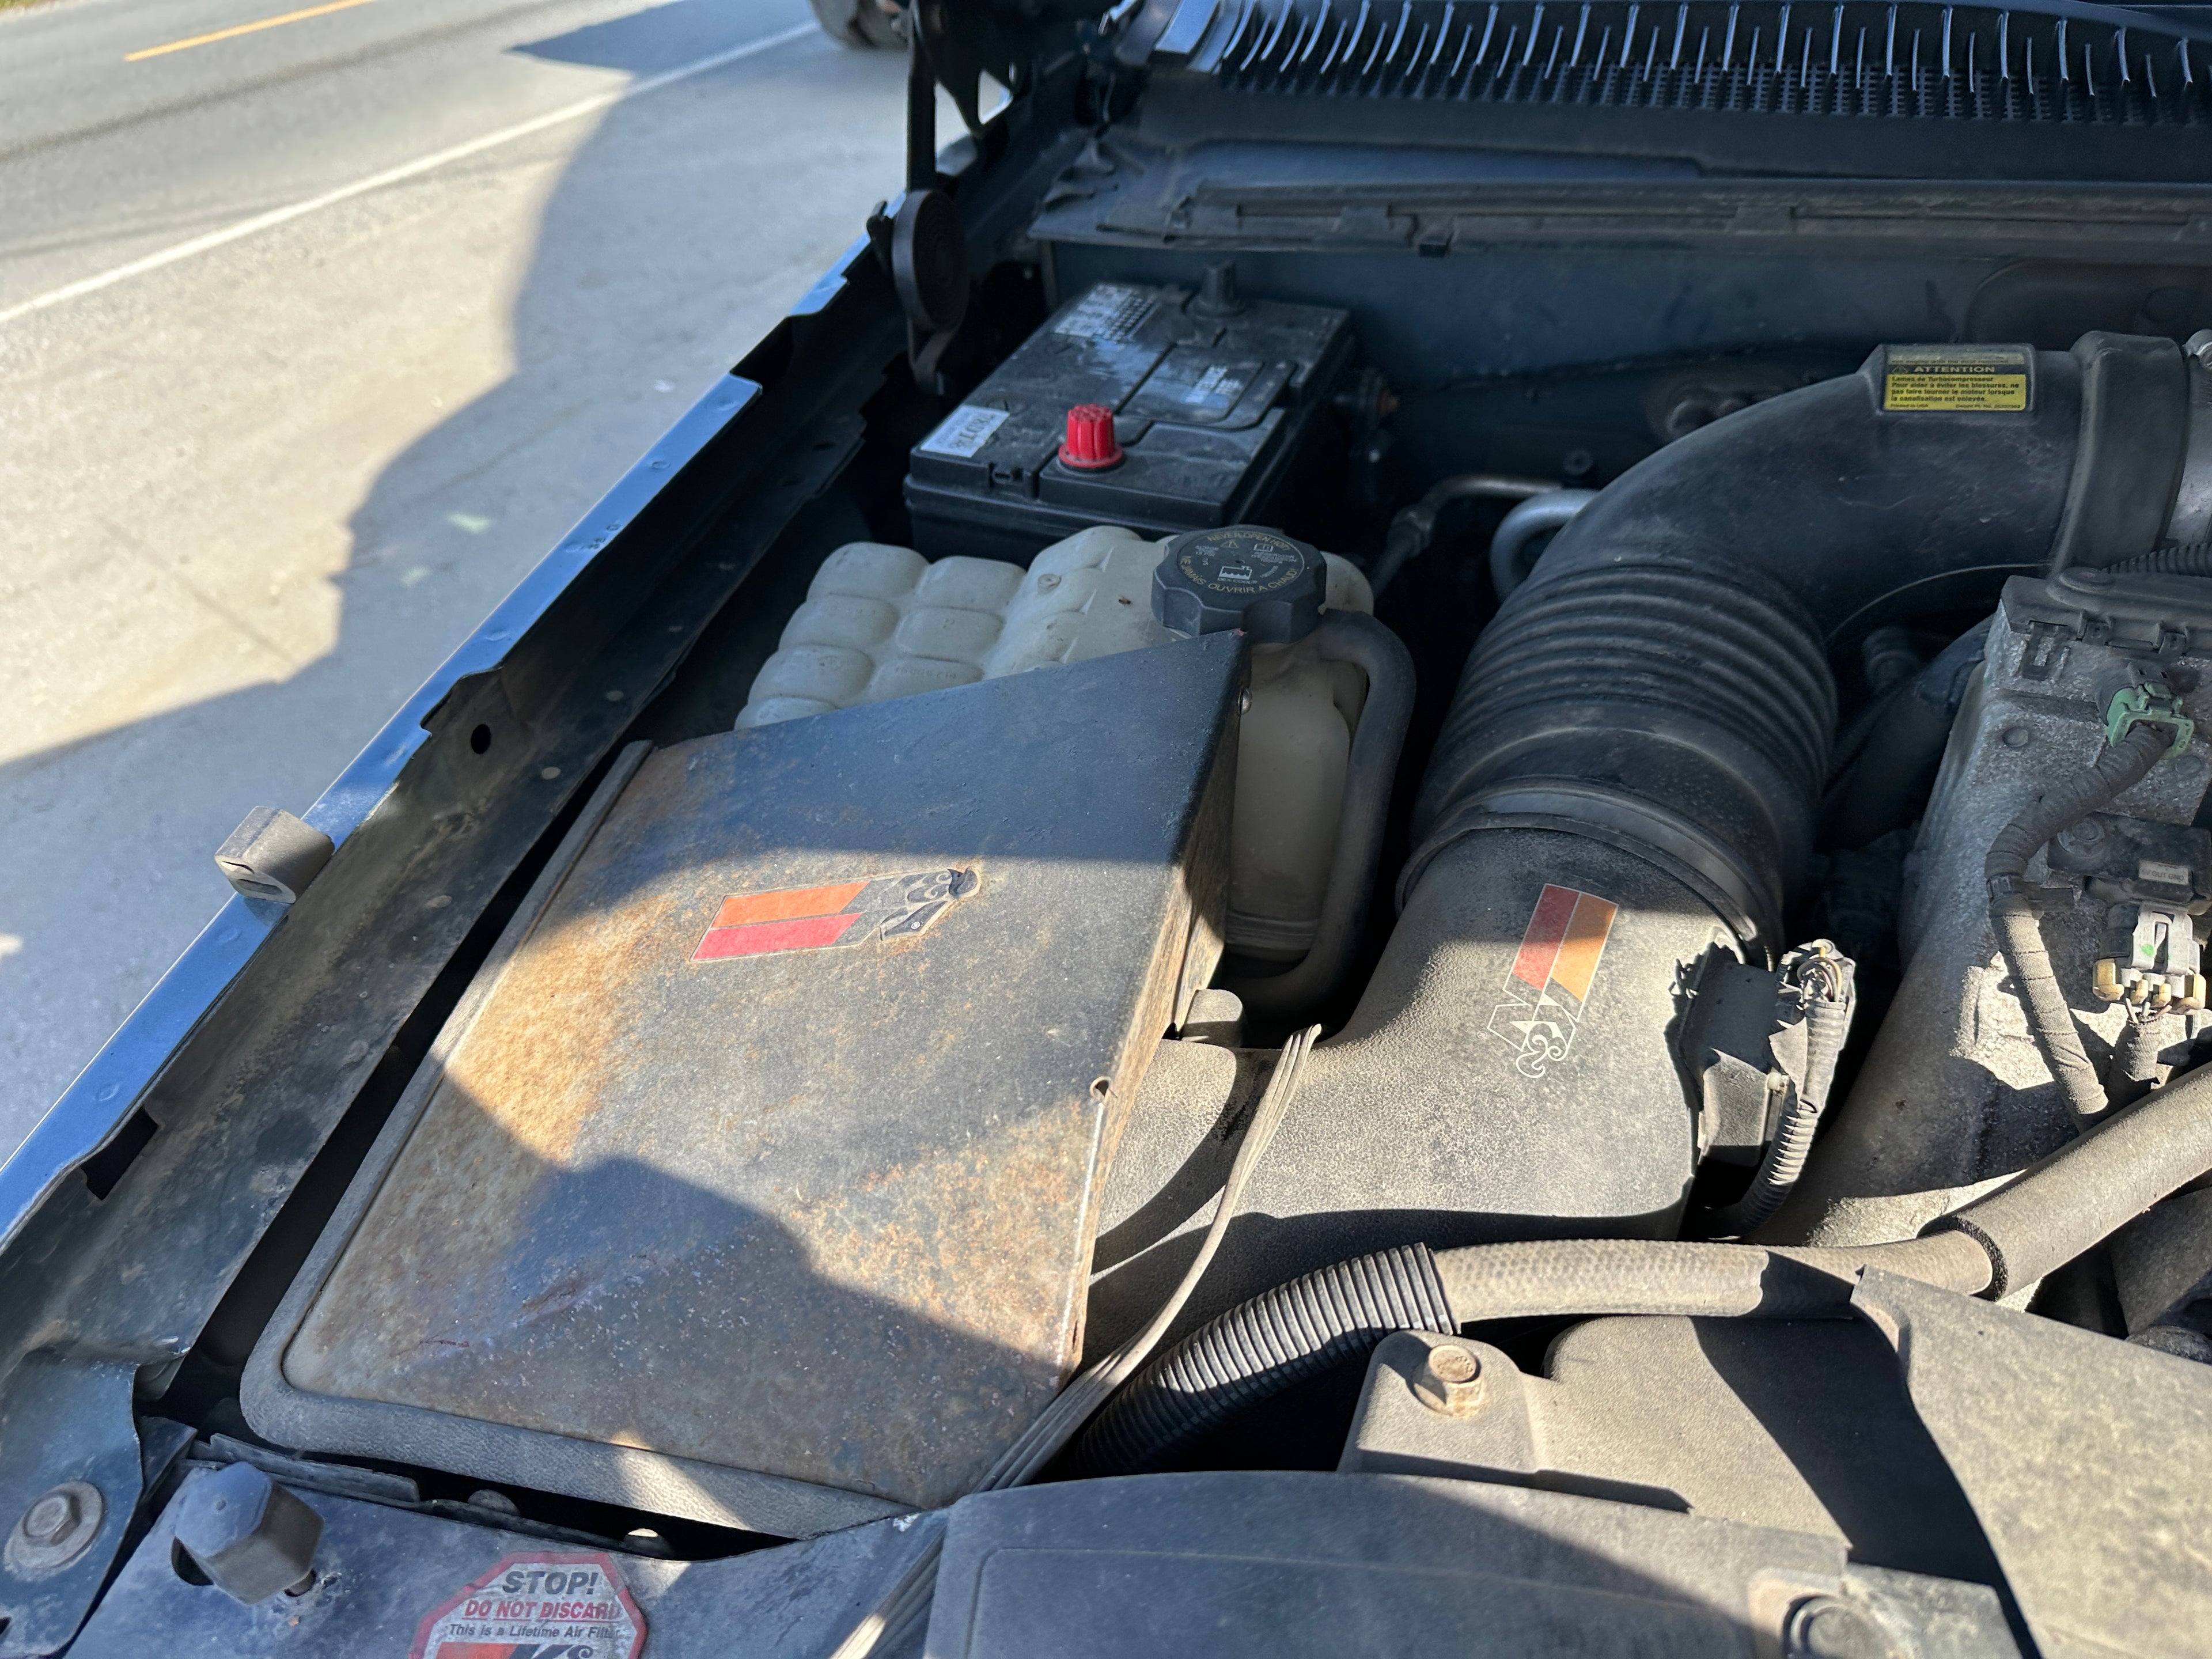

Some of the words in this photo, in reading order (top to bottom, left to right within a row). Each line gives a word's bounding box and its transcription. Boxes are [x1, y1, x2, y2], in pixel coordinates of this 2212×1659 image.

[1207, 532, 1243, 541] NEVER
[1208, 583, 1255, 593] OUVRIR
[502, 1570, 600, 1595] STOP!
[464, 1599, 493, 1616] DO
[495, 1600, 538, 1618] NOT
[539, 1601, 622, 1620] DISCARD
[450, 1623, 476, 1636] This
[480, 1624, 492, 1636] is
[509, 1624, 560, 1638] Lifetime
[564, 1625, 585, 1638] Air
